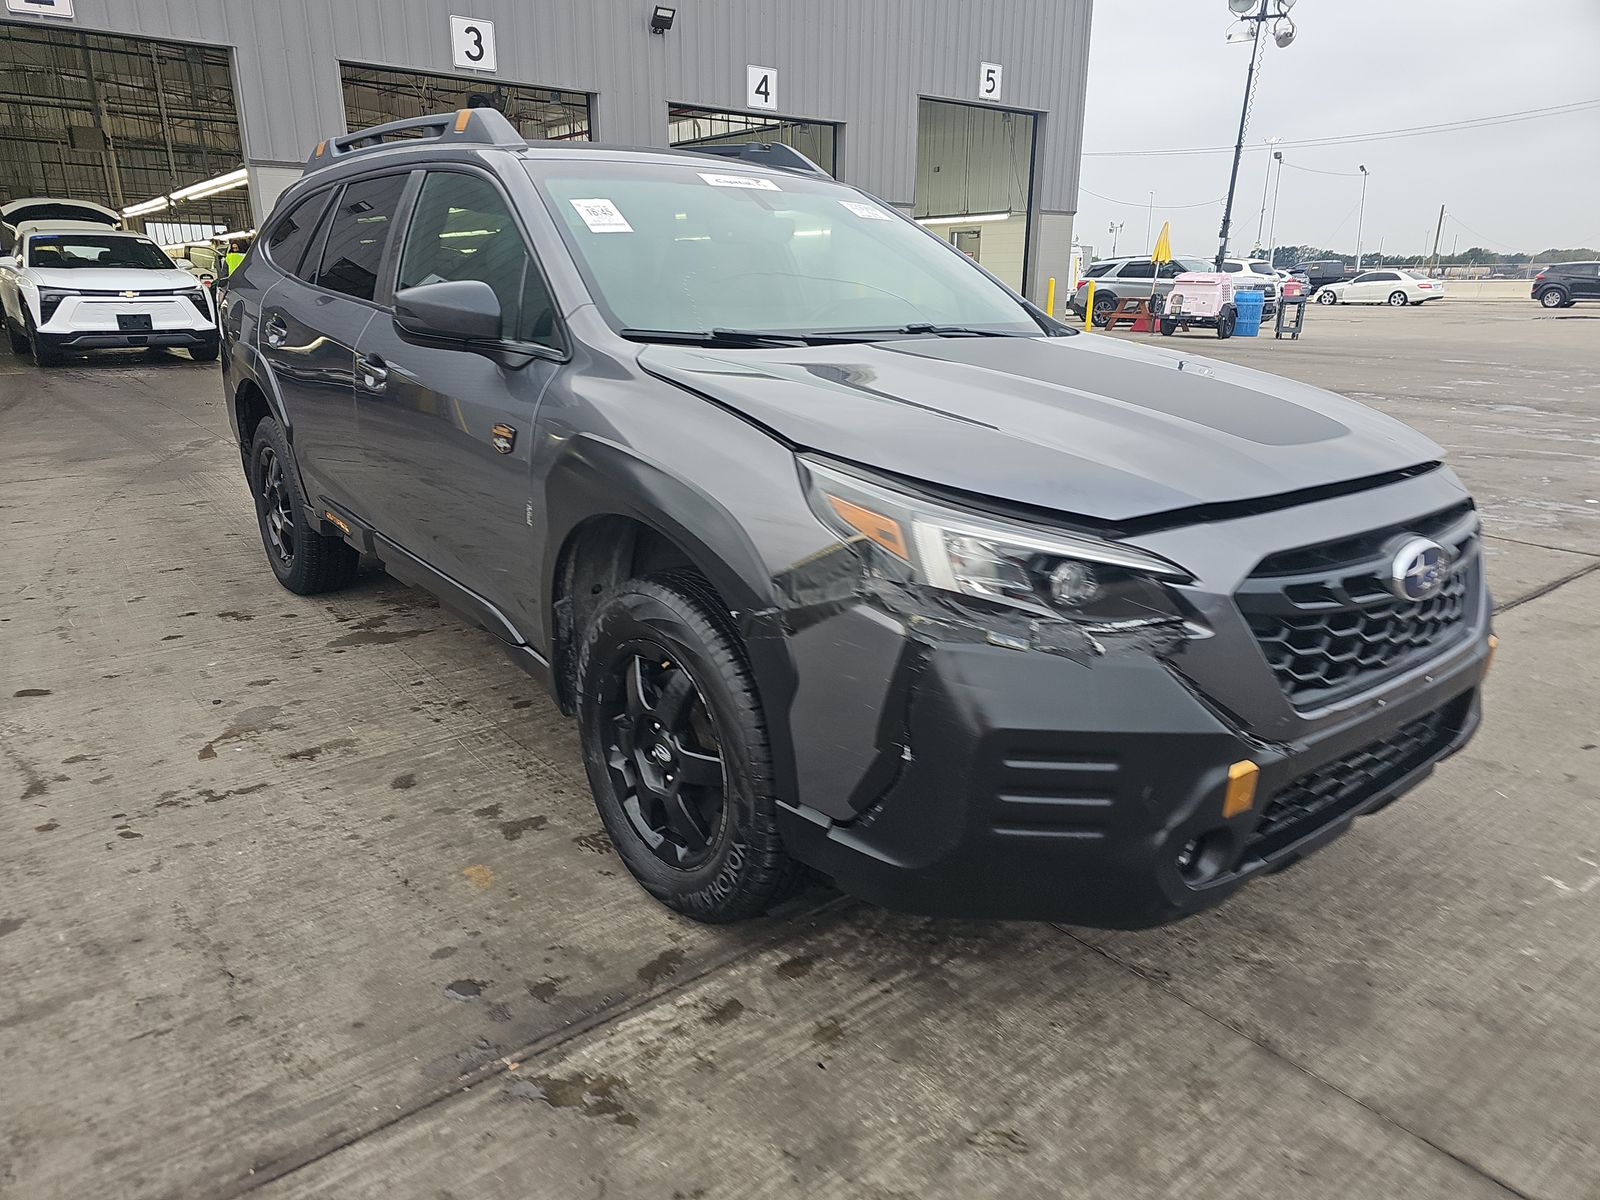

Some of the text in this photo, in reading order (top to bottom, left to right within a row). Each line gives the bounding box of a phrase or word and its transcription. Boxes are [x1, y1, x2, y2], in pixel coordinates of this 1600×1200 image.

[465, 27, 485, 61] 3
[754, 75, 770, 103] 4
[985, 68, 997, 95] 5
